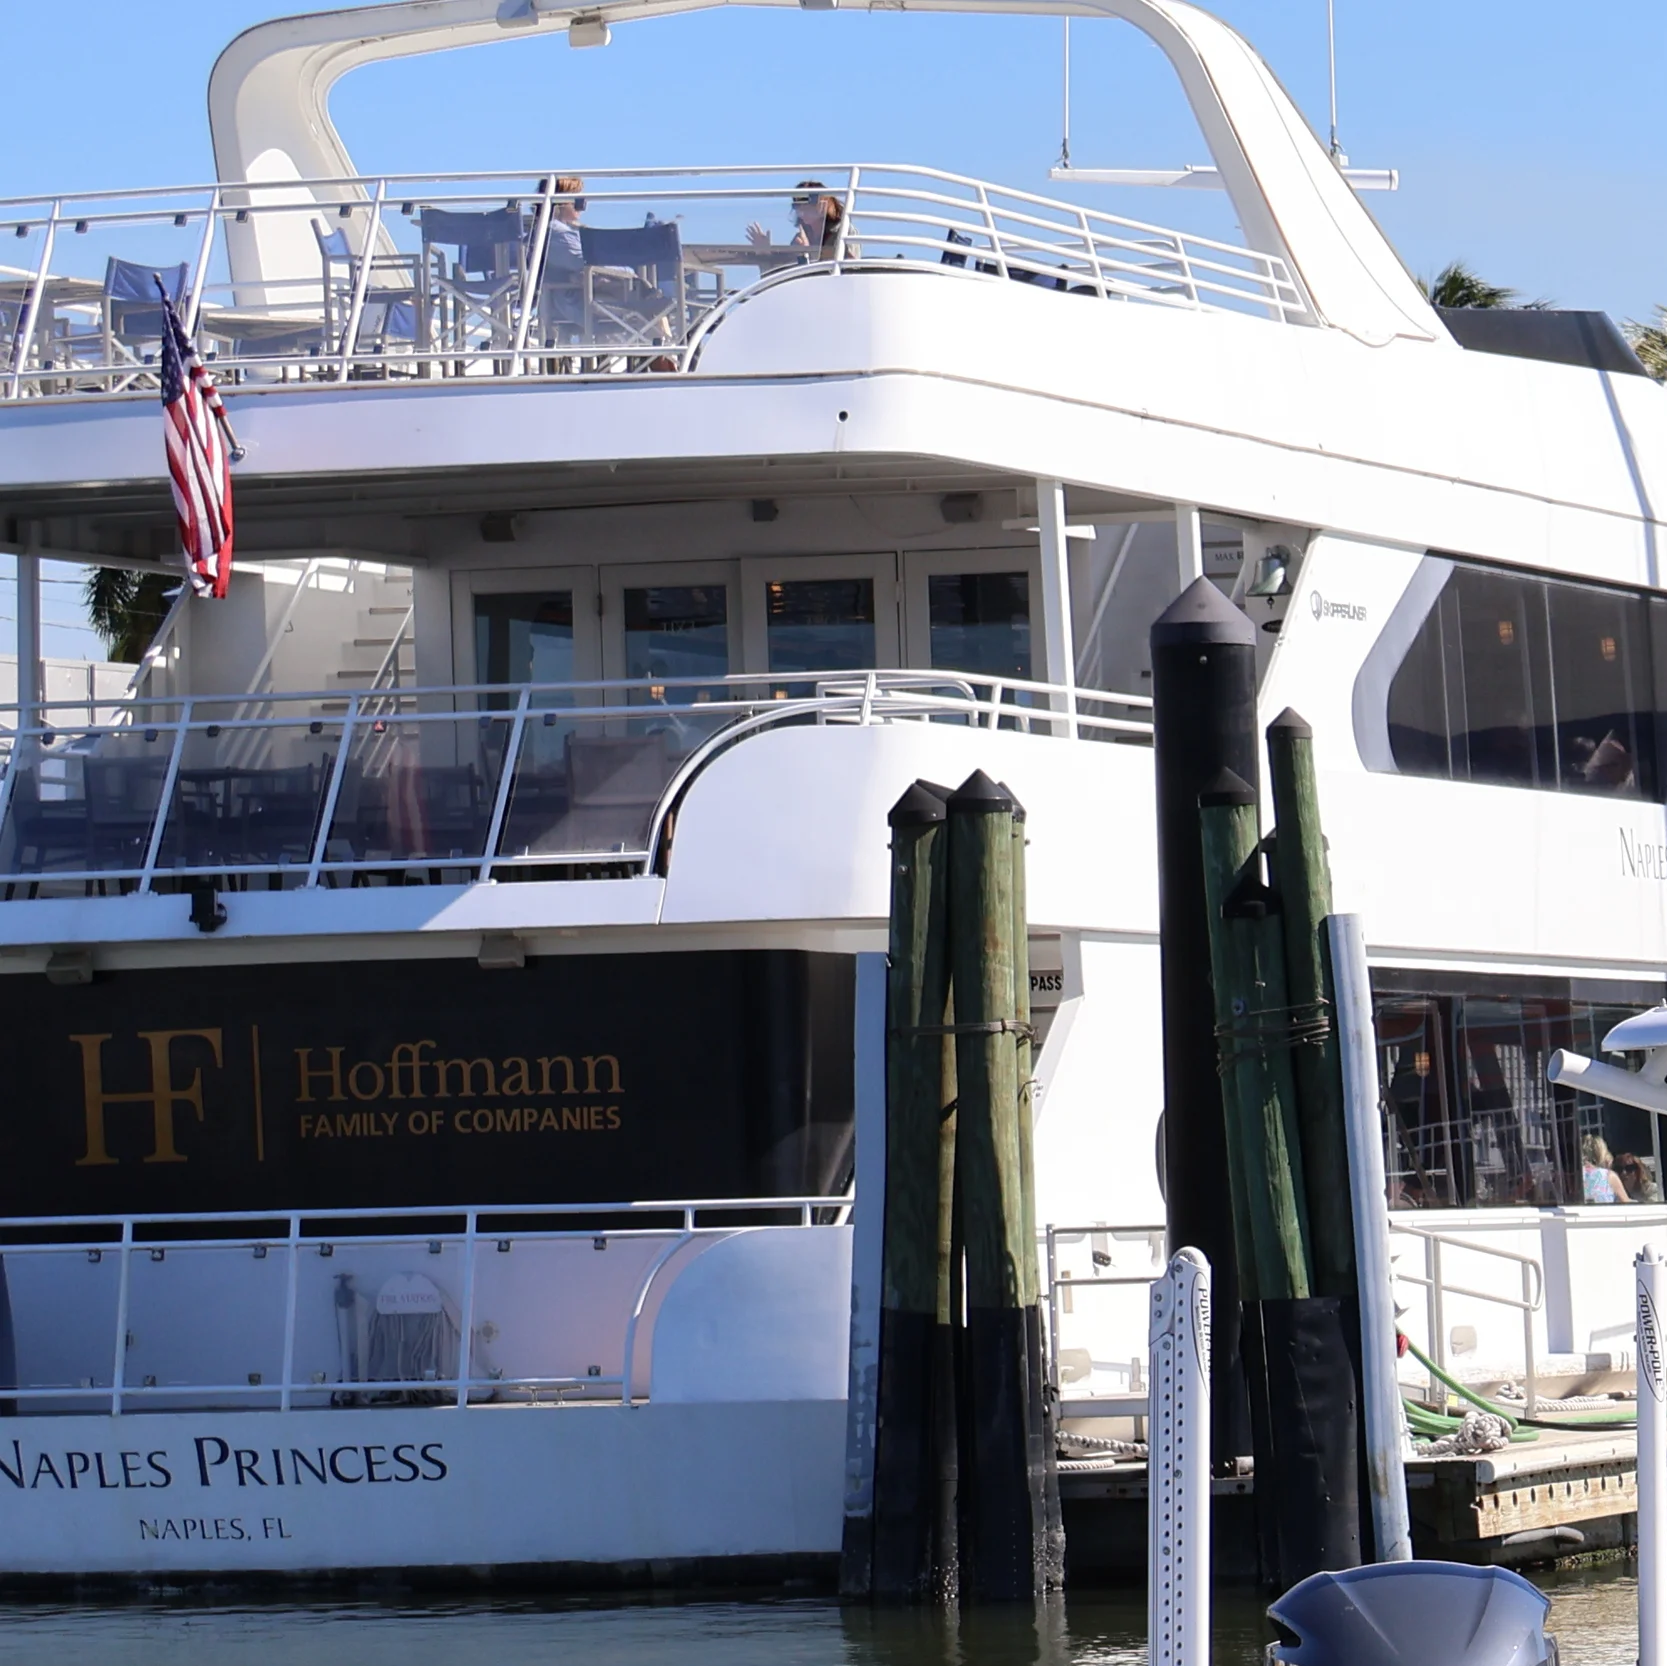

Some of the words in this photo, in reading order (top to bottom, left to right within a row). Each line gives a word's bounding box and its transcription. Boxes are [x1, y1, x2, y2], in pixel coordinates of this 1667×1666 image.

[294, 1040, 625, 1102] Hoffmann
[300, 1112, 399, 1138] FAMILY
[408, 1110, 444, 1135] OF
[454, 1106, 621, 1133] COMPANIES
[194, 1437, 447, 1486] PRINCESS
[139, 1518, 251, 1542] NAPLES,
[263, 1518, 292, 1539] FL
